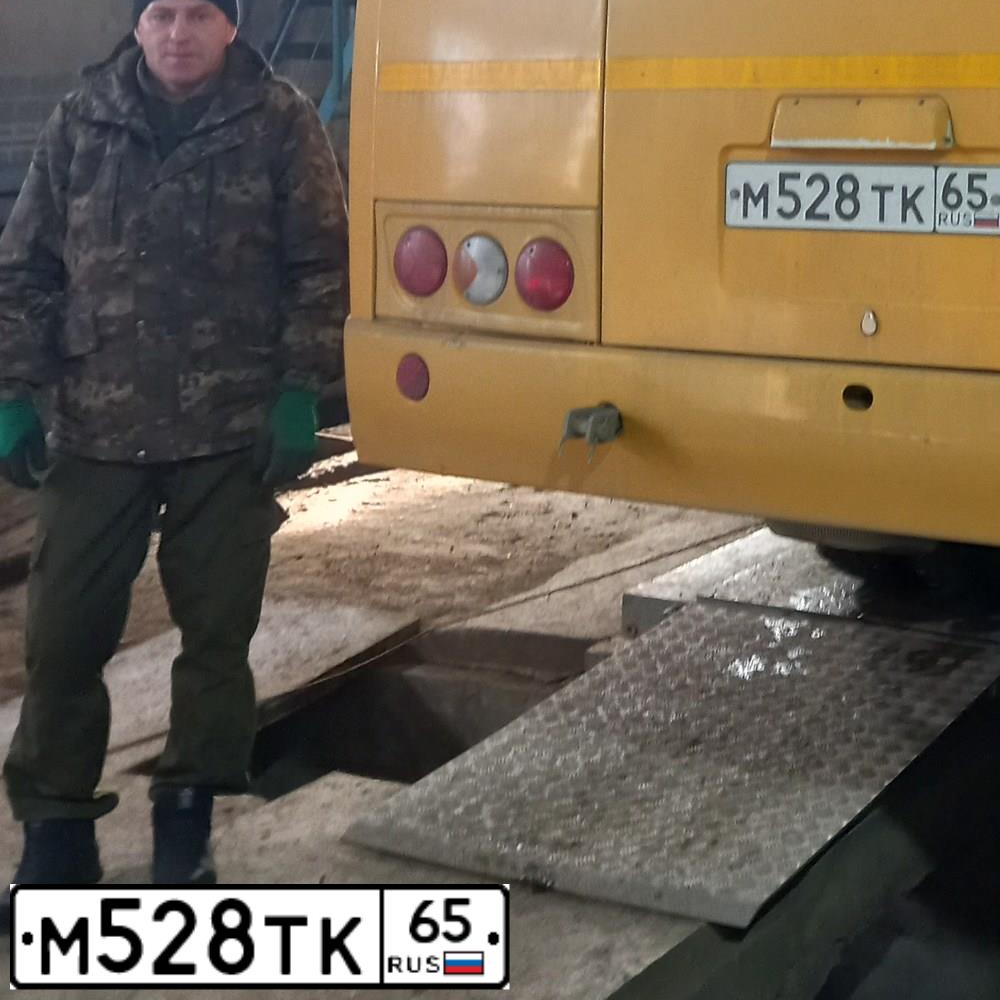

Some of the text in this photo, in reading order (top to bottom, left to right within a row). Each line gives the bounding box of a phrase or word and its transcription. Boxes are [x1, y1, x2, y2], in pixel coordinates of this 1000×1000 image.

[742, 172, 988, 224] М528ТК 65
[938, 212, 974, 227] RUS
